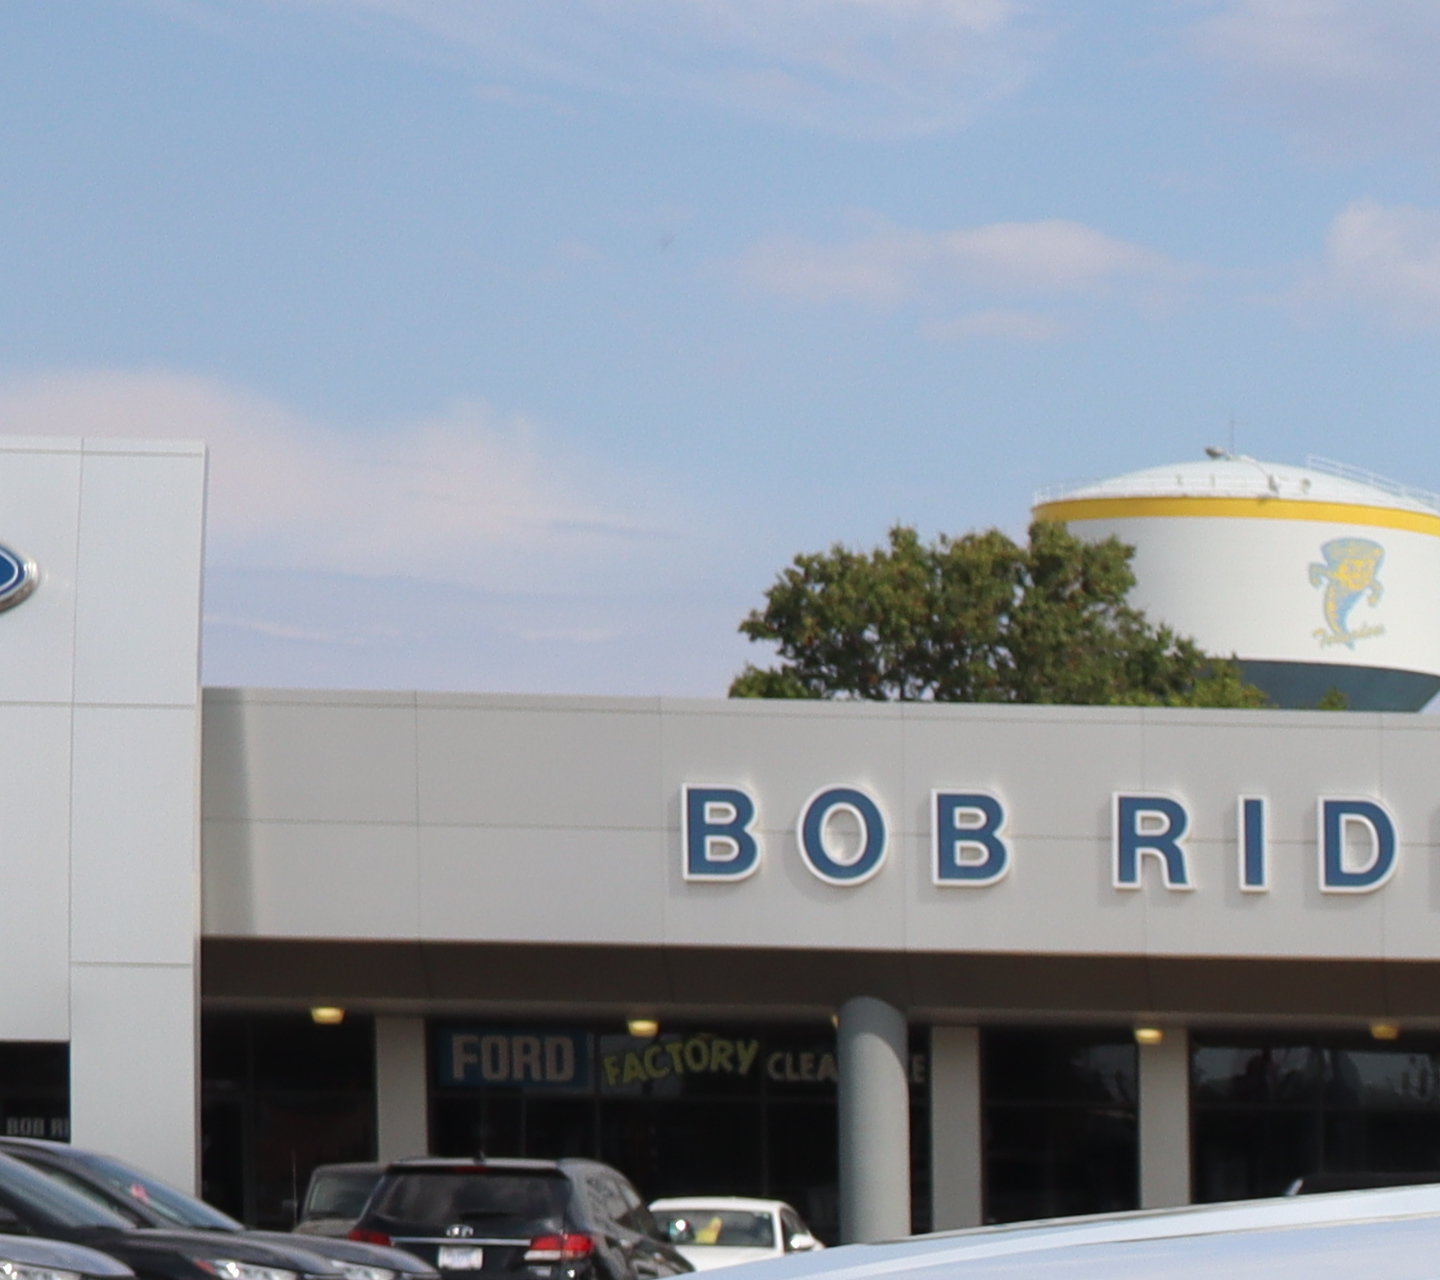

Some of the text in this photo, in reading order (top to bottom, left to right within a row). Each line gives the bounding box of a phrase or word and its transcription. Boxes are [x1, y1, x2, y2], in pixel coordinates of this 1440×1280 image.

[681, 781, 1011, 887] BOB
[452, 1034, 574, 1082] FORD
[602, 1037, 760, 1086] FACTORY
